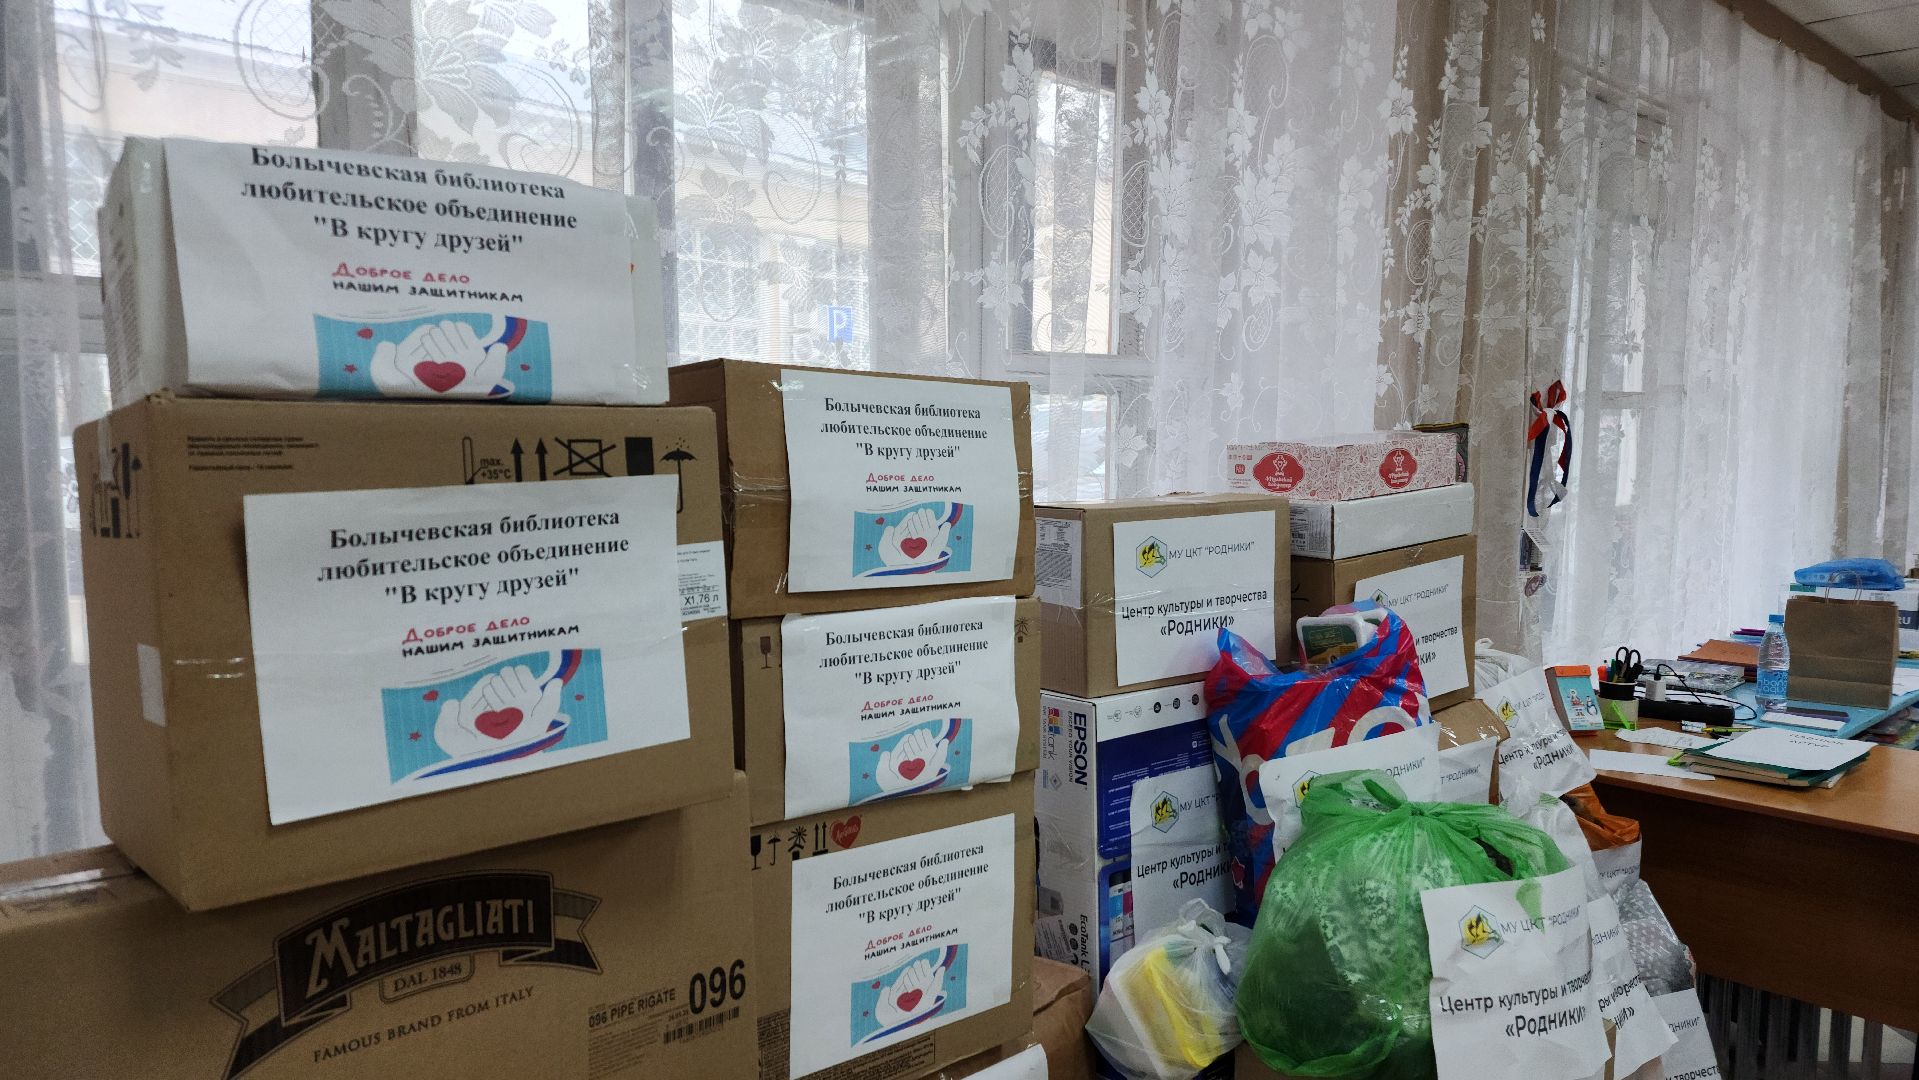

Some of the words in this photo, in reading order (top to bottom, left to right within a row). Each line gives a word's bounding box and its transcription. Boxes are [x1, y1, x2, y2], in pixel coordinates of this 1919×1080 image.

[251, 146, 427, 186] Болычевская
[434, 166, 565, 200] библиотека
[241, 178, 428, 215] любительское
[434, 197, 578, 230] объединение
[314, 216, 349, 238] "В
[356, 224, 427, 252] кругу
[433, 227, 523, 255] друзей"
[333, 281, 399, 295] НАШИМ
[408, 285, 524, 303] ЗАЩИТНИКАМ
[825, 397, 911, 416] Болычевская
[914, 402, 981, 419] библиотека
[820, 421, 911, 436] любительское
[915, 424, 987, 439] объединение
[856, 443, 874, 456] "В
[877, 444, 912, 459] кругу
[915, 445, 960, 460] друзей"
[481, 468, 511, 480] +35°C
[866, 485, 899, 493] НАШИМ
[903, 485, 962, 494] ЗАЩИТНИКАМ
[329, 520, 493, 550] Болычевская
[499, 509, 620, 535] библиотека
[317, 548, 491, 582] любительское
[497, 537, 629, 568] объединение
[1169, 549, 1183, 560] МУ
[1186, 546, 1202, 561] ЦКТ
[1204, 540, 1255, 557] "РОДНИКИ"
[385, 585, 417, 605] "В
[424, 579, 488, 605] кругу
[495, 570, 579, 599] друзей"
[1122, 602, 1154, 621] Центр
[1156, 599, 1204, 619] культуры
[1206, 597, 1212, 608] и
[1215, 590, 1268, 608] творчества
[402, 640, 464, 657] НАШИМ
[471, 624, 579, 648] ЗАЩИТНИКАМ
[825, 625, 914, 646] Болычевская
[917, 619, 983, 637] библиотека
[1160, 615, 1235, 636] «Родники»
[1421, 626, 1458, 644] творчества
[819, 648, 913, 669] любительское
[916, 639, 989, 658] объединение
[855, 671, 872, 685] "В
[876, 668, 913, 685] кругу
[915, 660, 961, 680] друзей"
[861, 709, 895, 721] НАШИМ
[900, 701, 961, 717] ЗАЩИТНИКАМ
[1074, 712, 1088, 786] EPSON
[1446, 764, 1481, 781] "РОДНИКИ"
[1180, 802, 1193, 812] МУ
[1195, 797, 1210, 809] ЦКТ
[832, 861, 917, 890] Болычевская
[920, 843, 984, 869] библиотека
[1137, 858, 1168, 878] Центр
[1170, 847, 1214, 871] культуры
[825, 881, 915, 914] любительское
[917, 862, 989, 890] объединение
[858, 910, 875, 924] "В
[878, 902, 913, 923] кругу
[916, 887, 961, 913] друзей"
[1080, 914, 1089, 957] EcoTank
[1501, 922, 1518, 935] МУ
[1520, 916, 1545, 933] ЦКТ
[305, 898, 537, 997] MALTAGLIATI
[864, 945, 897, 960] НАШИМ
[900, 927, 959, 951] ЗАЩИТНИКАМ
[393, 974, 424, 993] DAL
[430, 962, 463, 984] 1848
[689, 959, 746, 1014] 096
[588, 1011, 607, 1028] 096
[610, 1003, 635, 1021] PIPE
[637, 988, 676, 1011] RIGATE
[1440, 996, 1494, 1017] Центр
[1499, 984, 1559, 1009] культуры
[1561, 984, 1567, 996] и
[313, 1032, 381, 1062] FAMOUS
[387, 1014, 442, 1041] BRAND
[448, 999, 491, 1024] FROM
[496, 985, 536, 1012] ITALY
[1505, 1003, 1587, 1038] «Родники»
